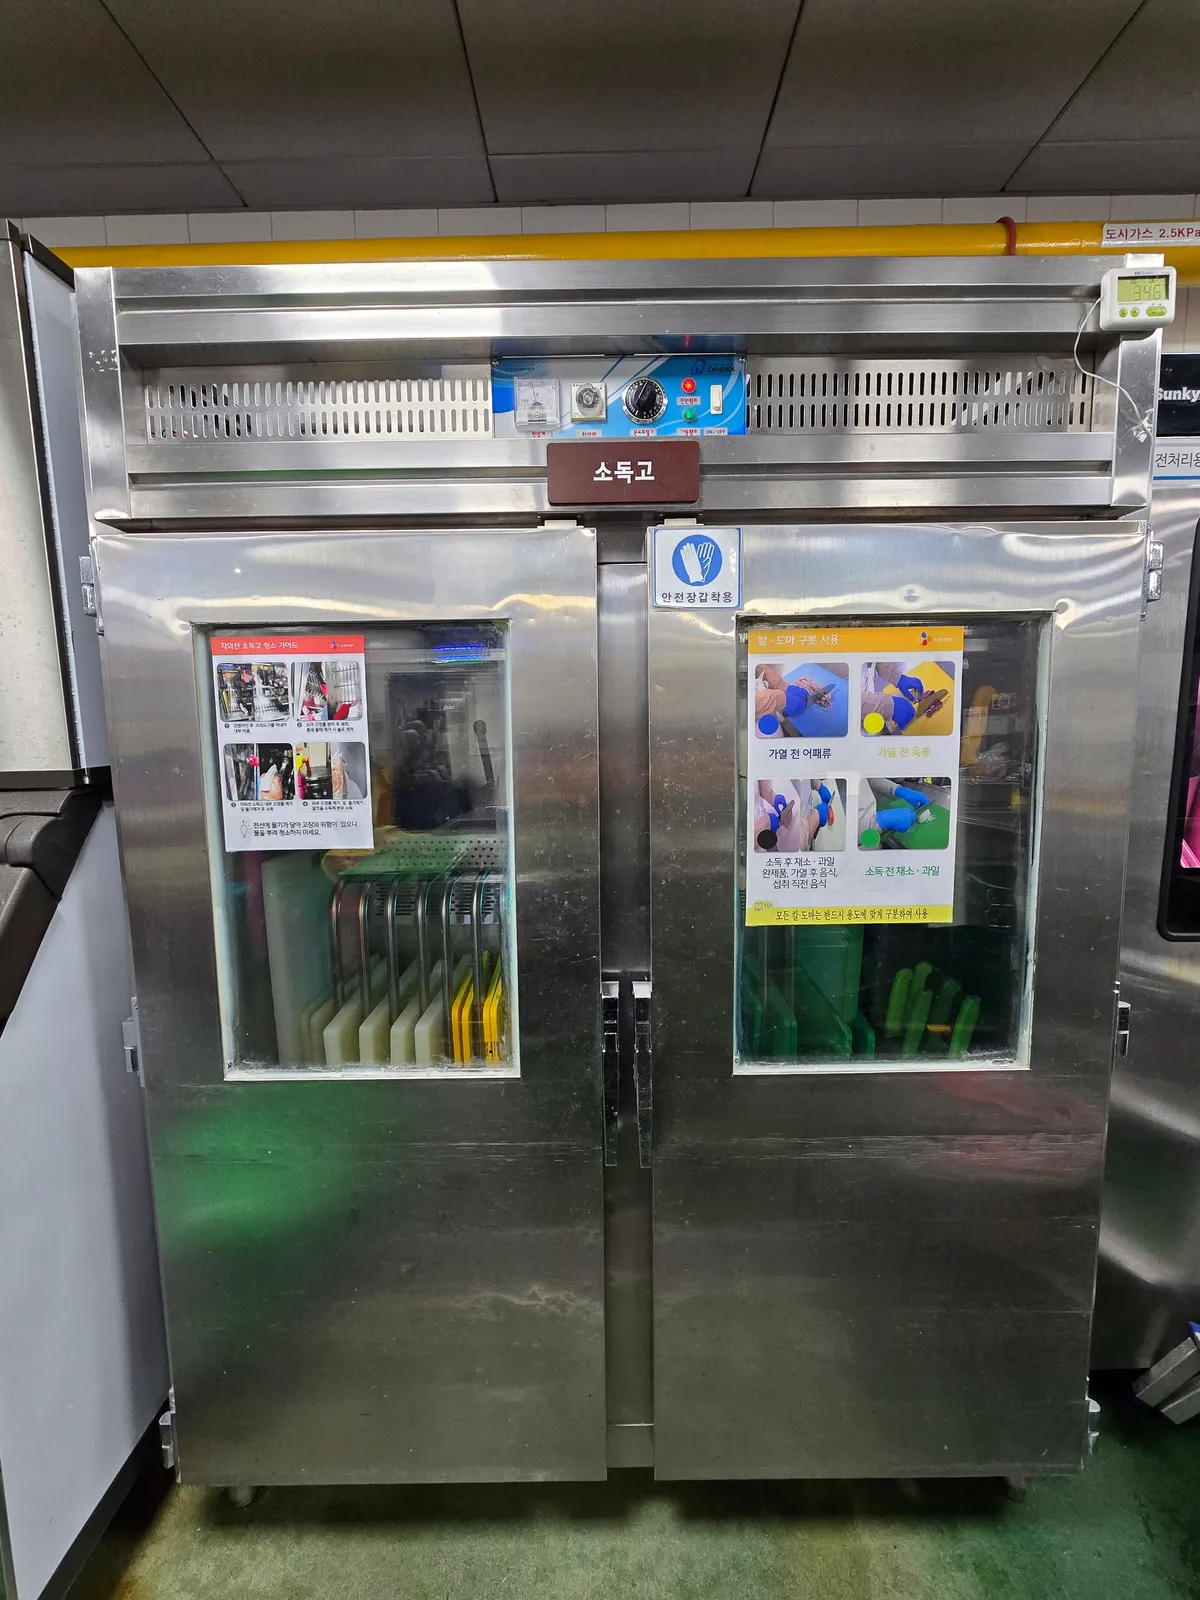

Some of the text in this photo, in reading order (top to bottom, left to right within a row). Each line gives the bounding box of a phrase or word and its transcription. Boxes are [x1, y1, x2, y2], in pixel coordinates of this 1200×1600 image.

[1106, 227, 1200, 240] 도시가스 2.5KPa
[593, 461, 655, 483] 소독고
[662, 592, 732, 603] 안전장갑착용
[220, 642, 240, 650] 자외선
[279, 641, 298, 649] 가이드
[758, 635, 767, 646] 칼
[777, 635, 795, 645] 도마
[798, 635, 816, 645] 구분
[820, 634, 839, 645] 사용
[768, 748, 832, 760] 가열 전 어패류
[877, 746, 931, 758] 가열 전 육류
[341, 820, 358, 828] 있으니
[765, 857, 782, 867] 소독
[784, 857, 793, 867] 후
[794, 856, 811, 867] 채소
[818, 856, 835, 866] 과일
[762, 867, 838, 879] 완제품, 가열 후 음식,
[865, 866, 884, 877] 소독
[885, 866, 895, 877] 전
[896, 865, 914, 877] 채소
[921, 865, 940, 876] 과일
[772, 878, 827, 889] 섭취 직전 음식
[775, 908, 928, 921] 모든 칼·도마는 반드시 용도에 맞게 구분하여 사용
